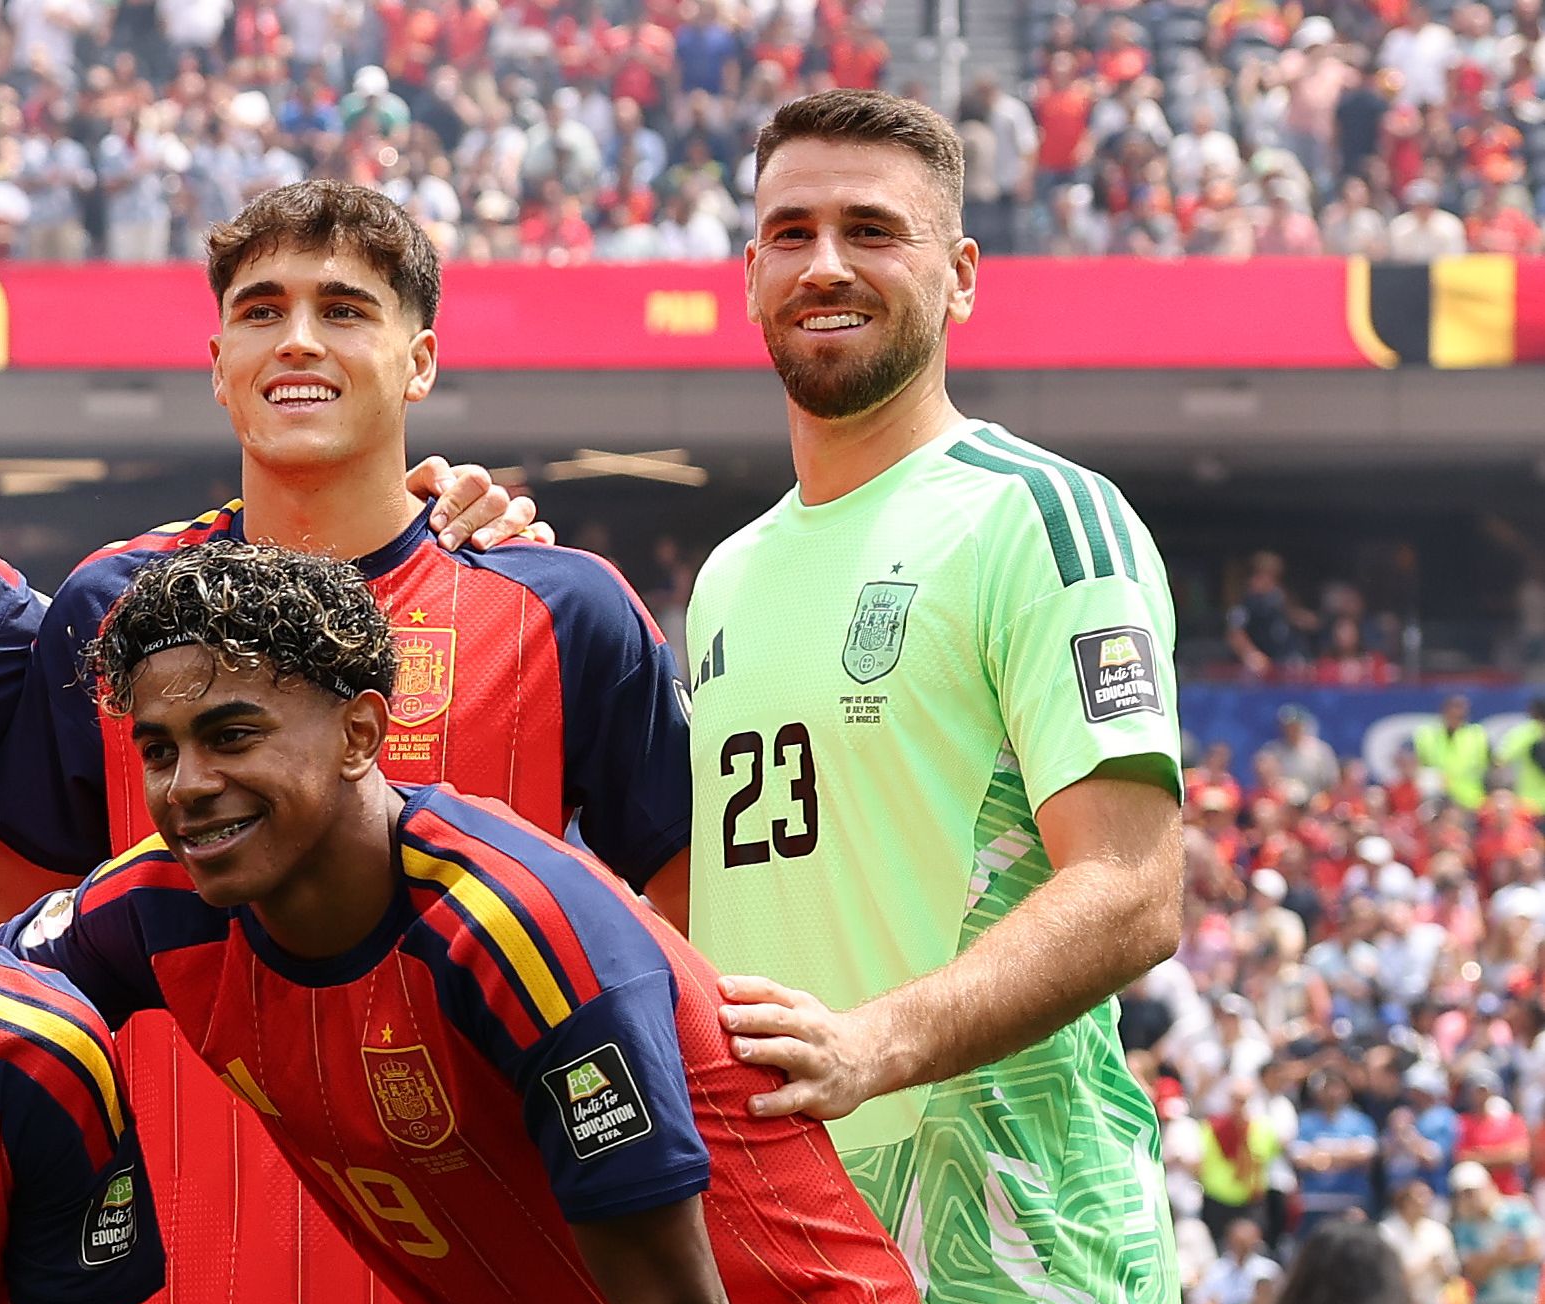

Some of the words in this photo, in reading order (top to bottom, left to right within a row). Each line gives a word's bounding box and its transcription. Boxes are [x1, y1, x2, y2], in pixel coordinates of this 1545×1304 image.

[167, 632, 192, 645] YAM
[1100, 666, 1129, 687] Unite
[1094, 680, 1155, 704] EDUCATION
[1115, 696, 1139, 708] FIFA
[719, 722, 818, 869] 23
[573, 1098, 603, 1122] Unite
[600, 1089, 619, 1109] For
[572, 1103, 637, 1141] EDUCATION
[597, 1128, 622, 1144] FIFA
[98, 1209, 127, 1228] Unite
[311, 1155, 450, 1260] 19
[92, 1221, 133, 1247] EDUCAT
[111, 1241, 129, 1254] FIFA
